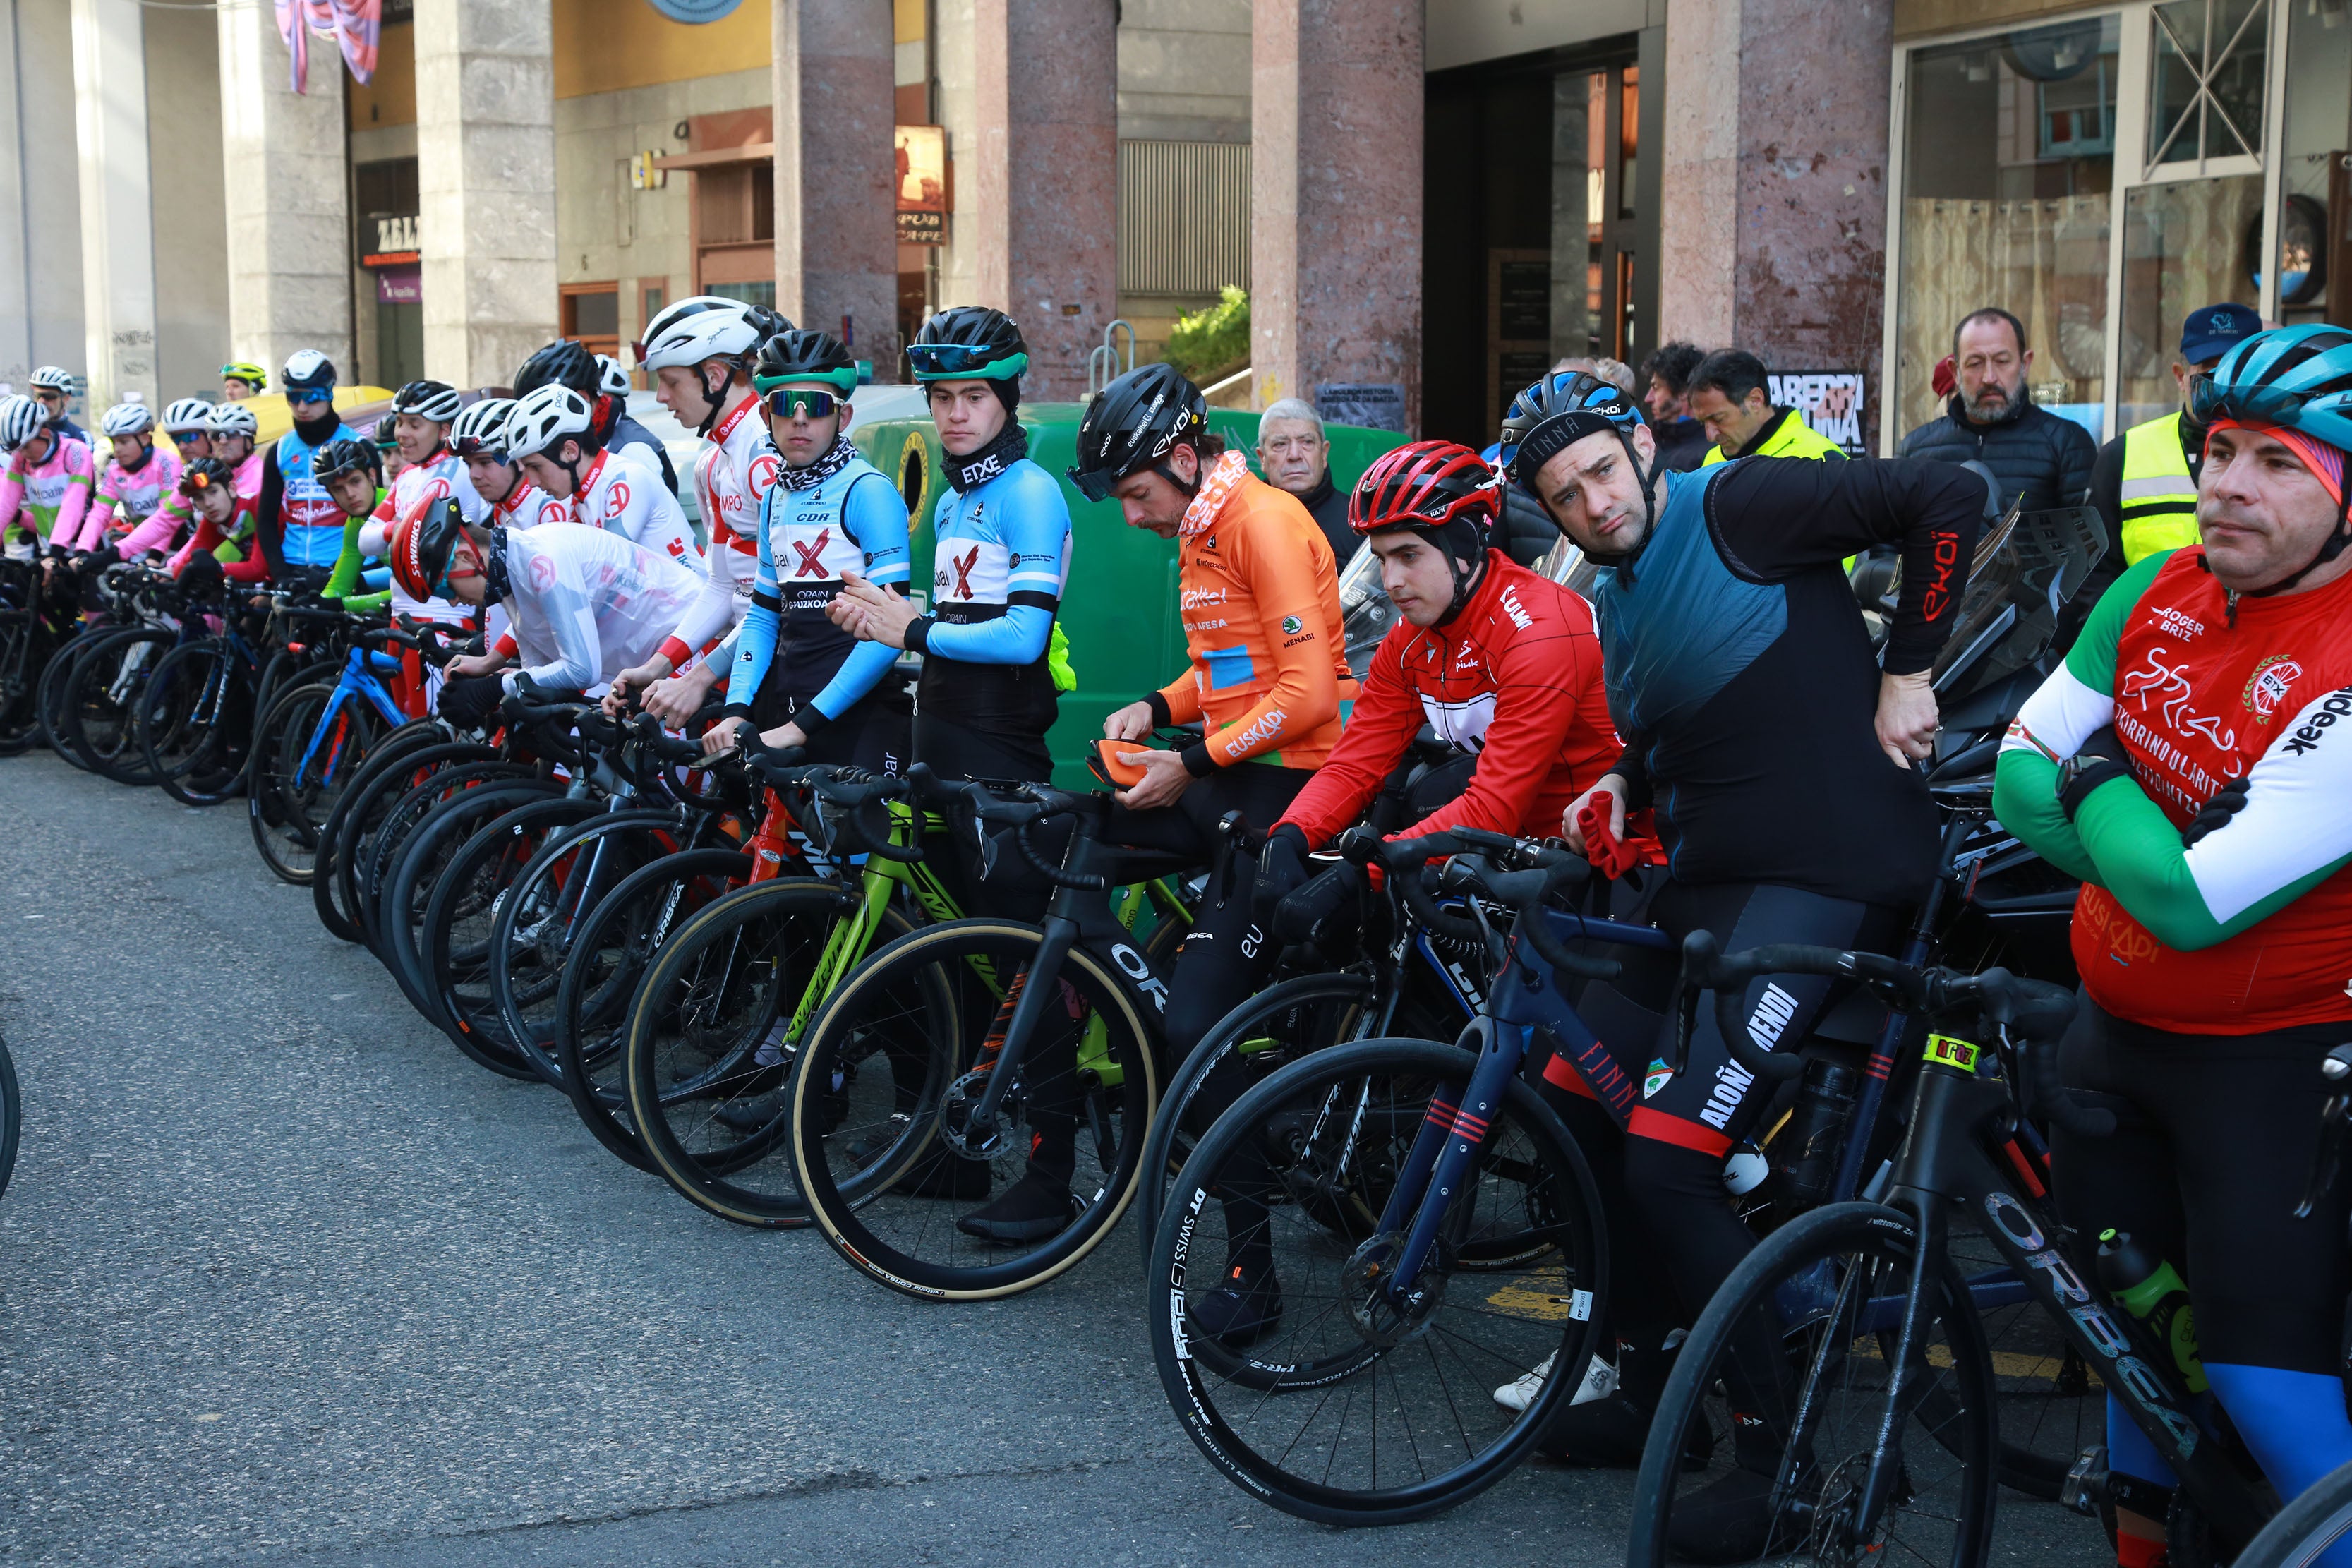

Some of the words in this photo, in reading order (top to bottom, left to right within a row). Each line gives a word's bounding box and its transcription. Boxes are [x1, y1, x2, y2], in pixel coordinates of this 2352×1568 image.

[897, 213, 939, 226] PUB
[1767, 374, 1864, 409] ABERRI
[727, 409, 745, 430] AMPO
[1128, 419, 1148, 448] euskaltel
[586, 467, 600, 486] AMPO
[960, 454, 1001, 484] ETXE
[517, 484, 530, 502] AMPO
[720, 494, 742, 512] MPO
[796, 513, 830, 522] CDR
[1430, 507, 1446, 517] KASK
[410, 519, 422, 578] S-WORKS
[1504, 597, 1533, 632] ULMA
[2161, 607, 2205, 636] ROGER
[1283, 632, 1315, 649] MENABI
[2159, 620, 2193, 643] BRIZ
[654, 883, 685, 949] ORBEA
[1577, 1040, 1639, 1120] FINN
[1699, 1058, 1755, 1130] ALOÑ
[1188, 1188, 1207, 1216] DT
[1873, 1217, 1902, 1230] vittoria
[1175, 1215, 1195, 1261] SWISS
[884, 1273, 913, 1289] CORSA
[917, 1285, 940, 1296] vittoria
[1576, 1310, 1586, 1319] DT
[1984, 1191, 2201, 1461] ORBEA
